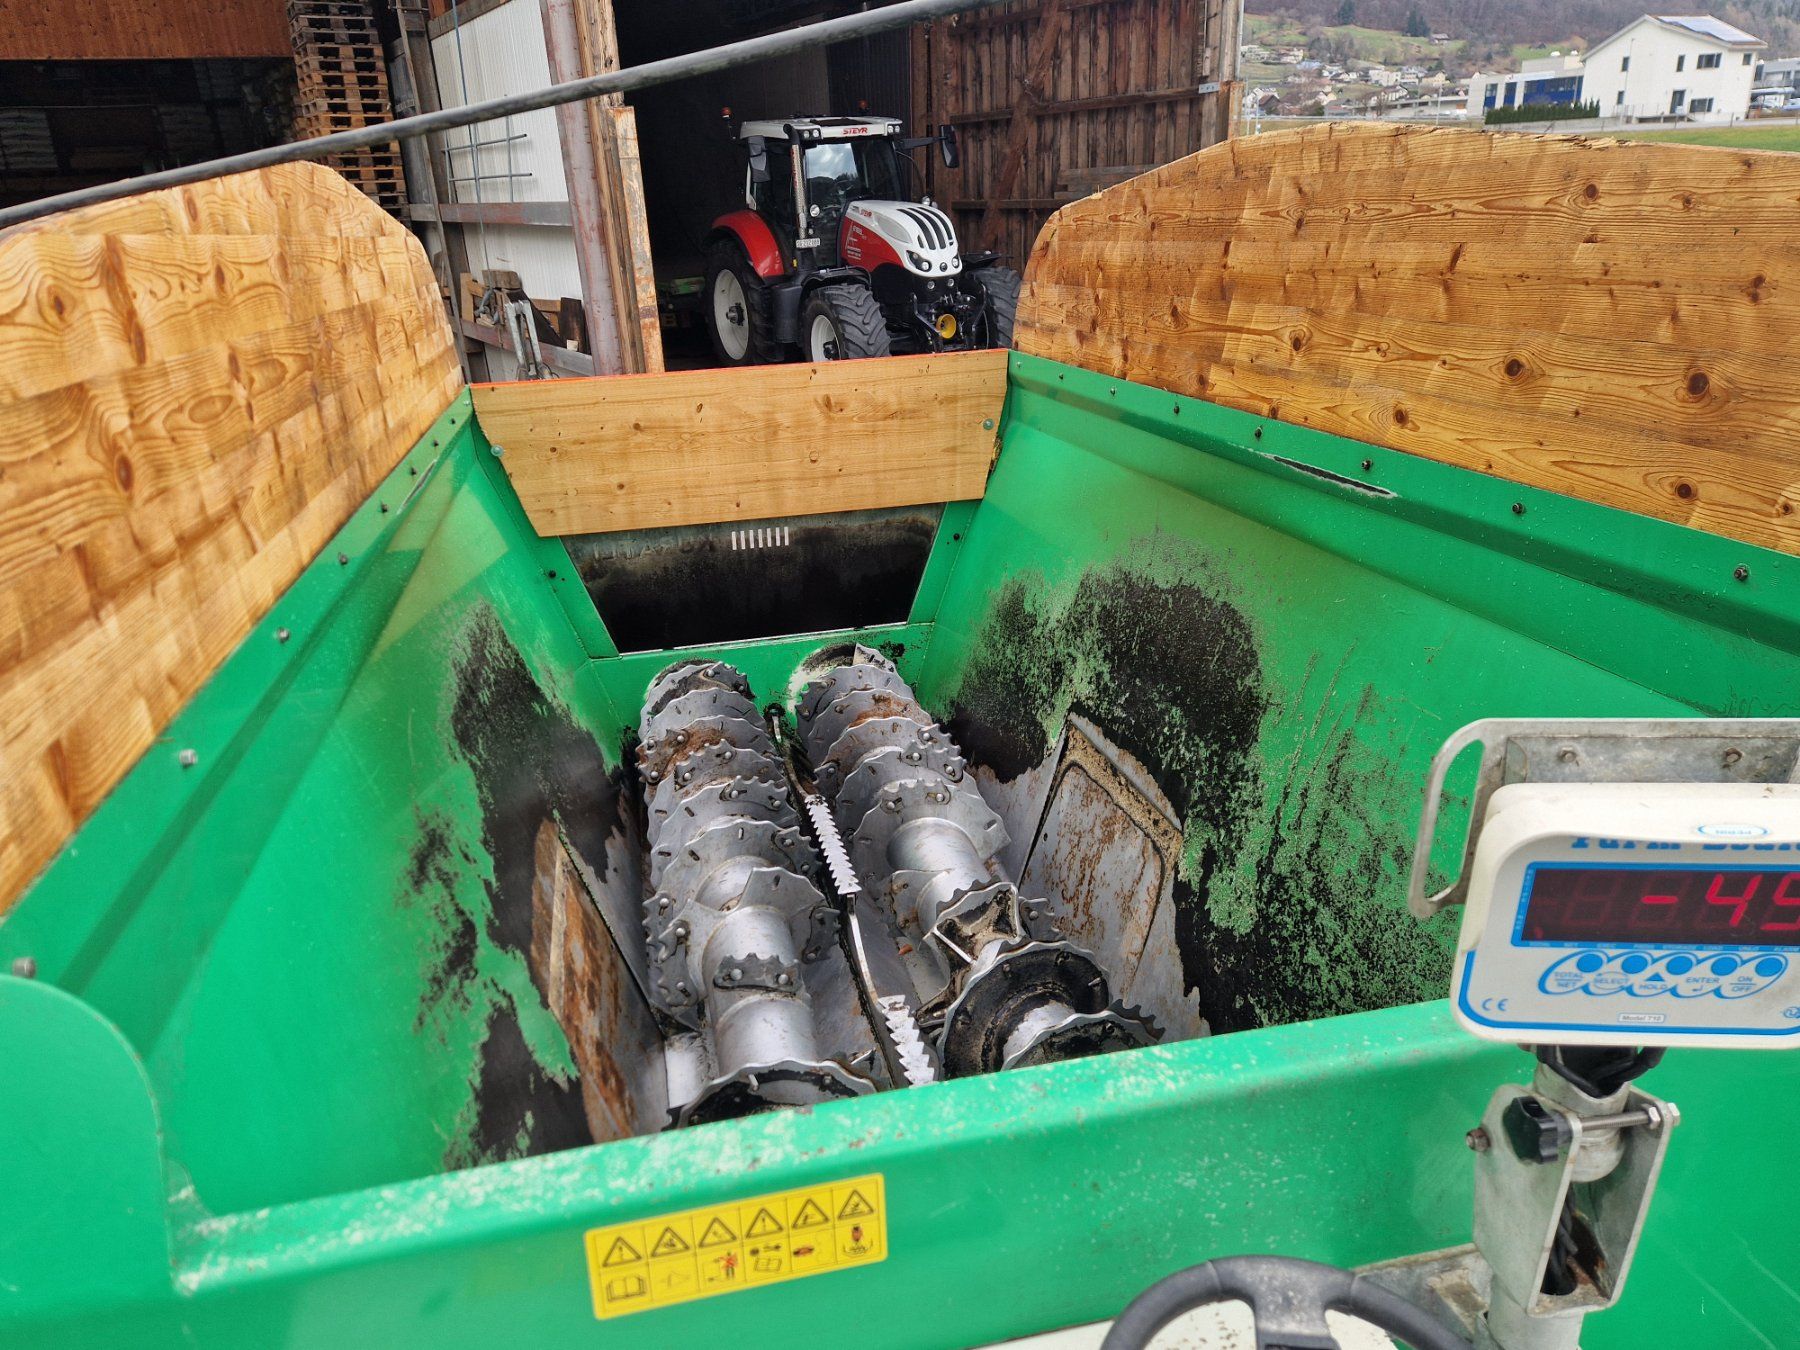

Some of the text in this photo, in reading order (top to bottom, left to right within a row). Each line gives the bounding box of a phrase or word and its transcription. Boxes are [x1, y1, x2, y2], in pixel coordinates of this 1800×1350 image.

[842, 127, 868, 135] STEYR
[1554, 971, 1584, 979] TOTAL
[1737, 975, 1754, 983] ON
[1594, 977, 1629, 985] SELECT
[1685, 976, 1720, 985] ENTER
[1638, 983, 1667, 991] HOLD
[1621, 1014, 1646, 1022] Model
